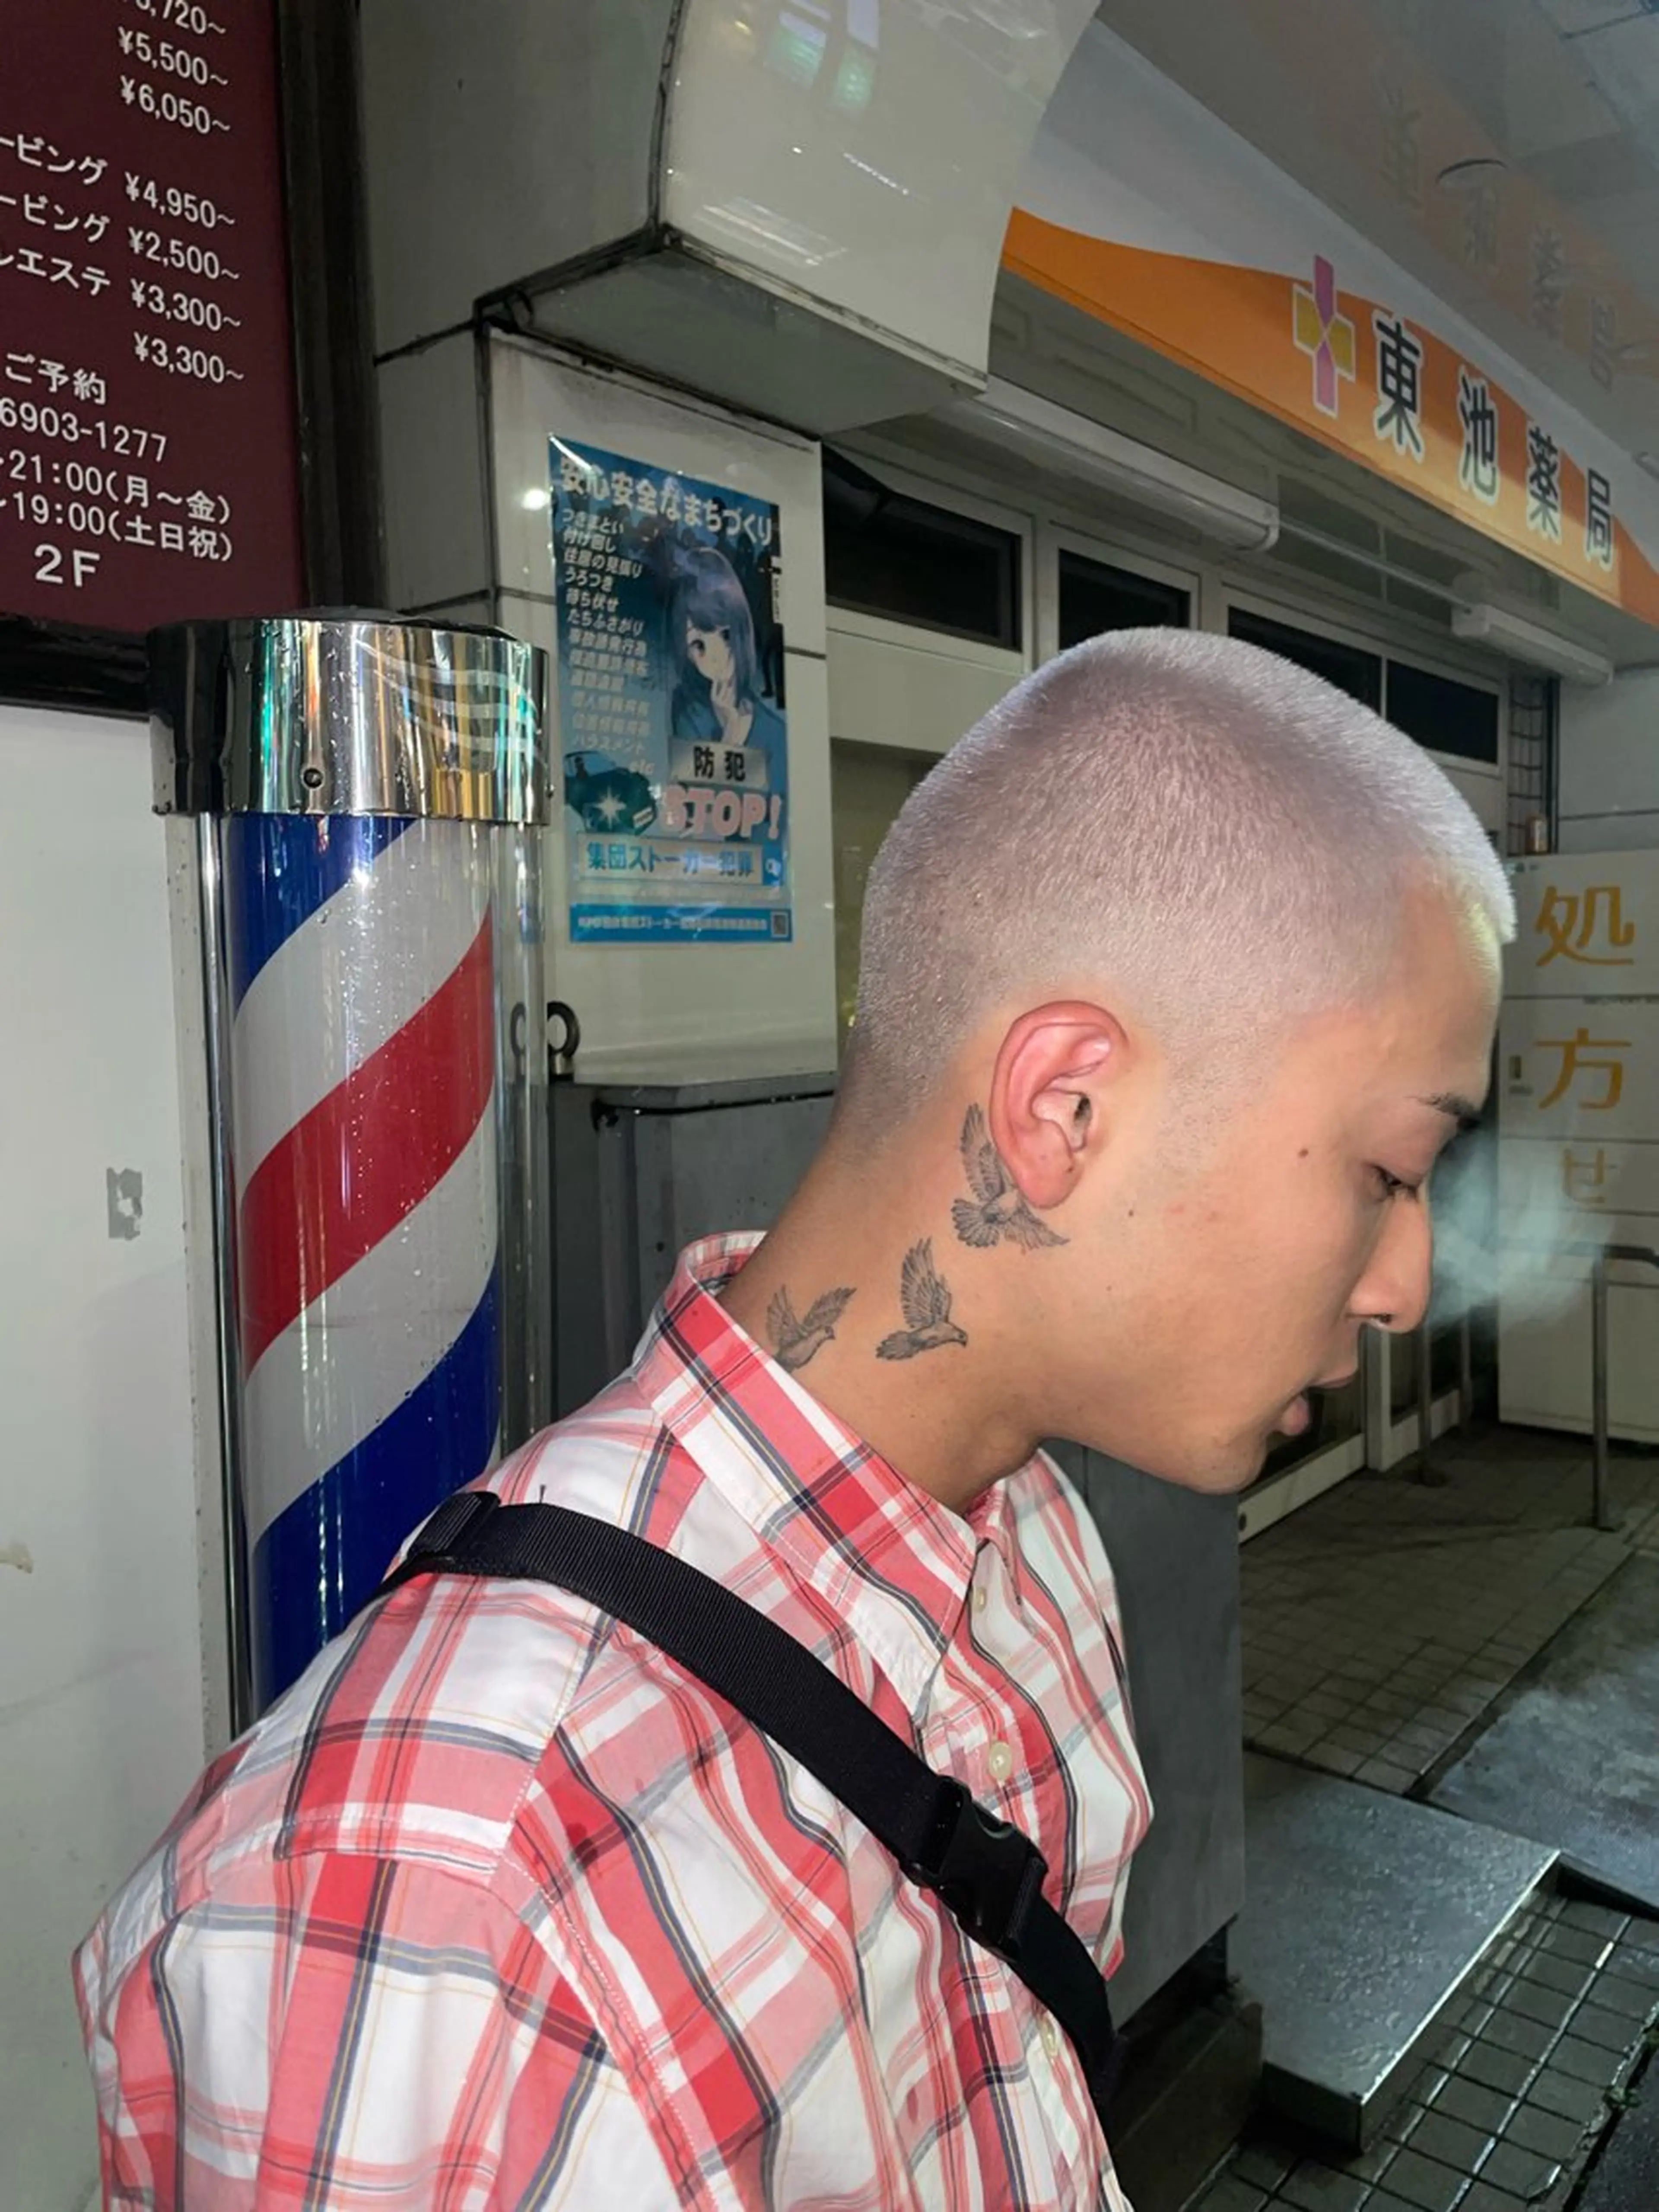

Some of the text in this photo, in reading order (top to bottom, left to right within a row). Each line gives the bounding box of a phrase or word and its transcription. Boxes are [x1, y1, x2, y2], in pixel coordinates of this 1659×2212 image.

[118, 26, 228, 85] ¥5,500~
[121, 75, 230, 134] ¥6,050~
[125, 172, 235, 228] ¥4,950~
[128, 227, 240, 280] ¥2,500~
[130, 278, 241, 331] ¥3,300~
[5, 353, 106, 405] ご予約
[133, 332, 244, 383] ¥3,300~
[0, 397, 167, 462] 6903-1277
[1373, 308, 1613, 572] 東池薬局
[35, 544, 100, 587] 2F
[693, 745, 747, 782] 防犯
[660, 784, 782, 840] STOP!
